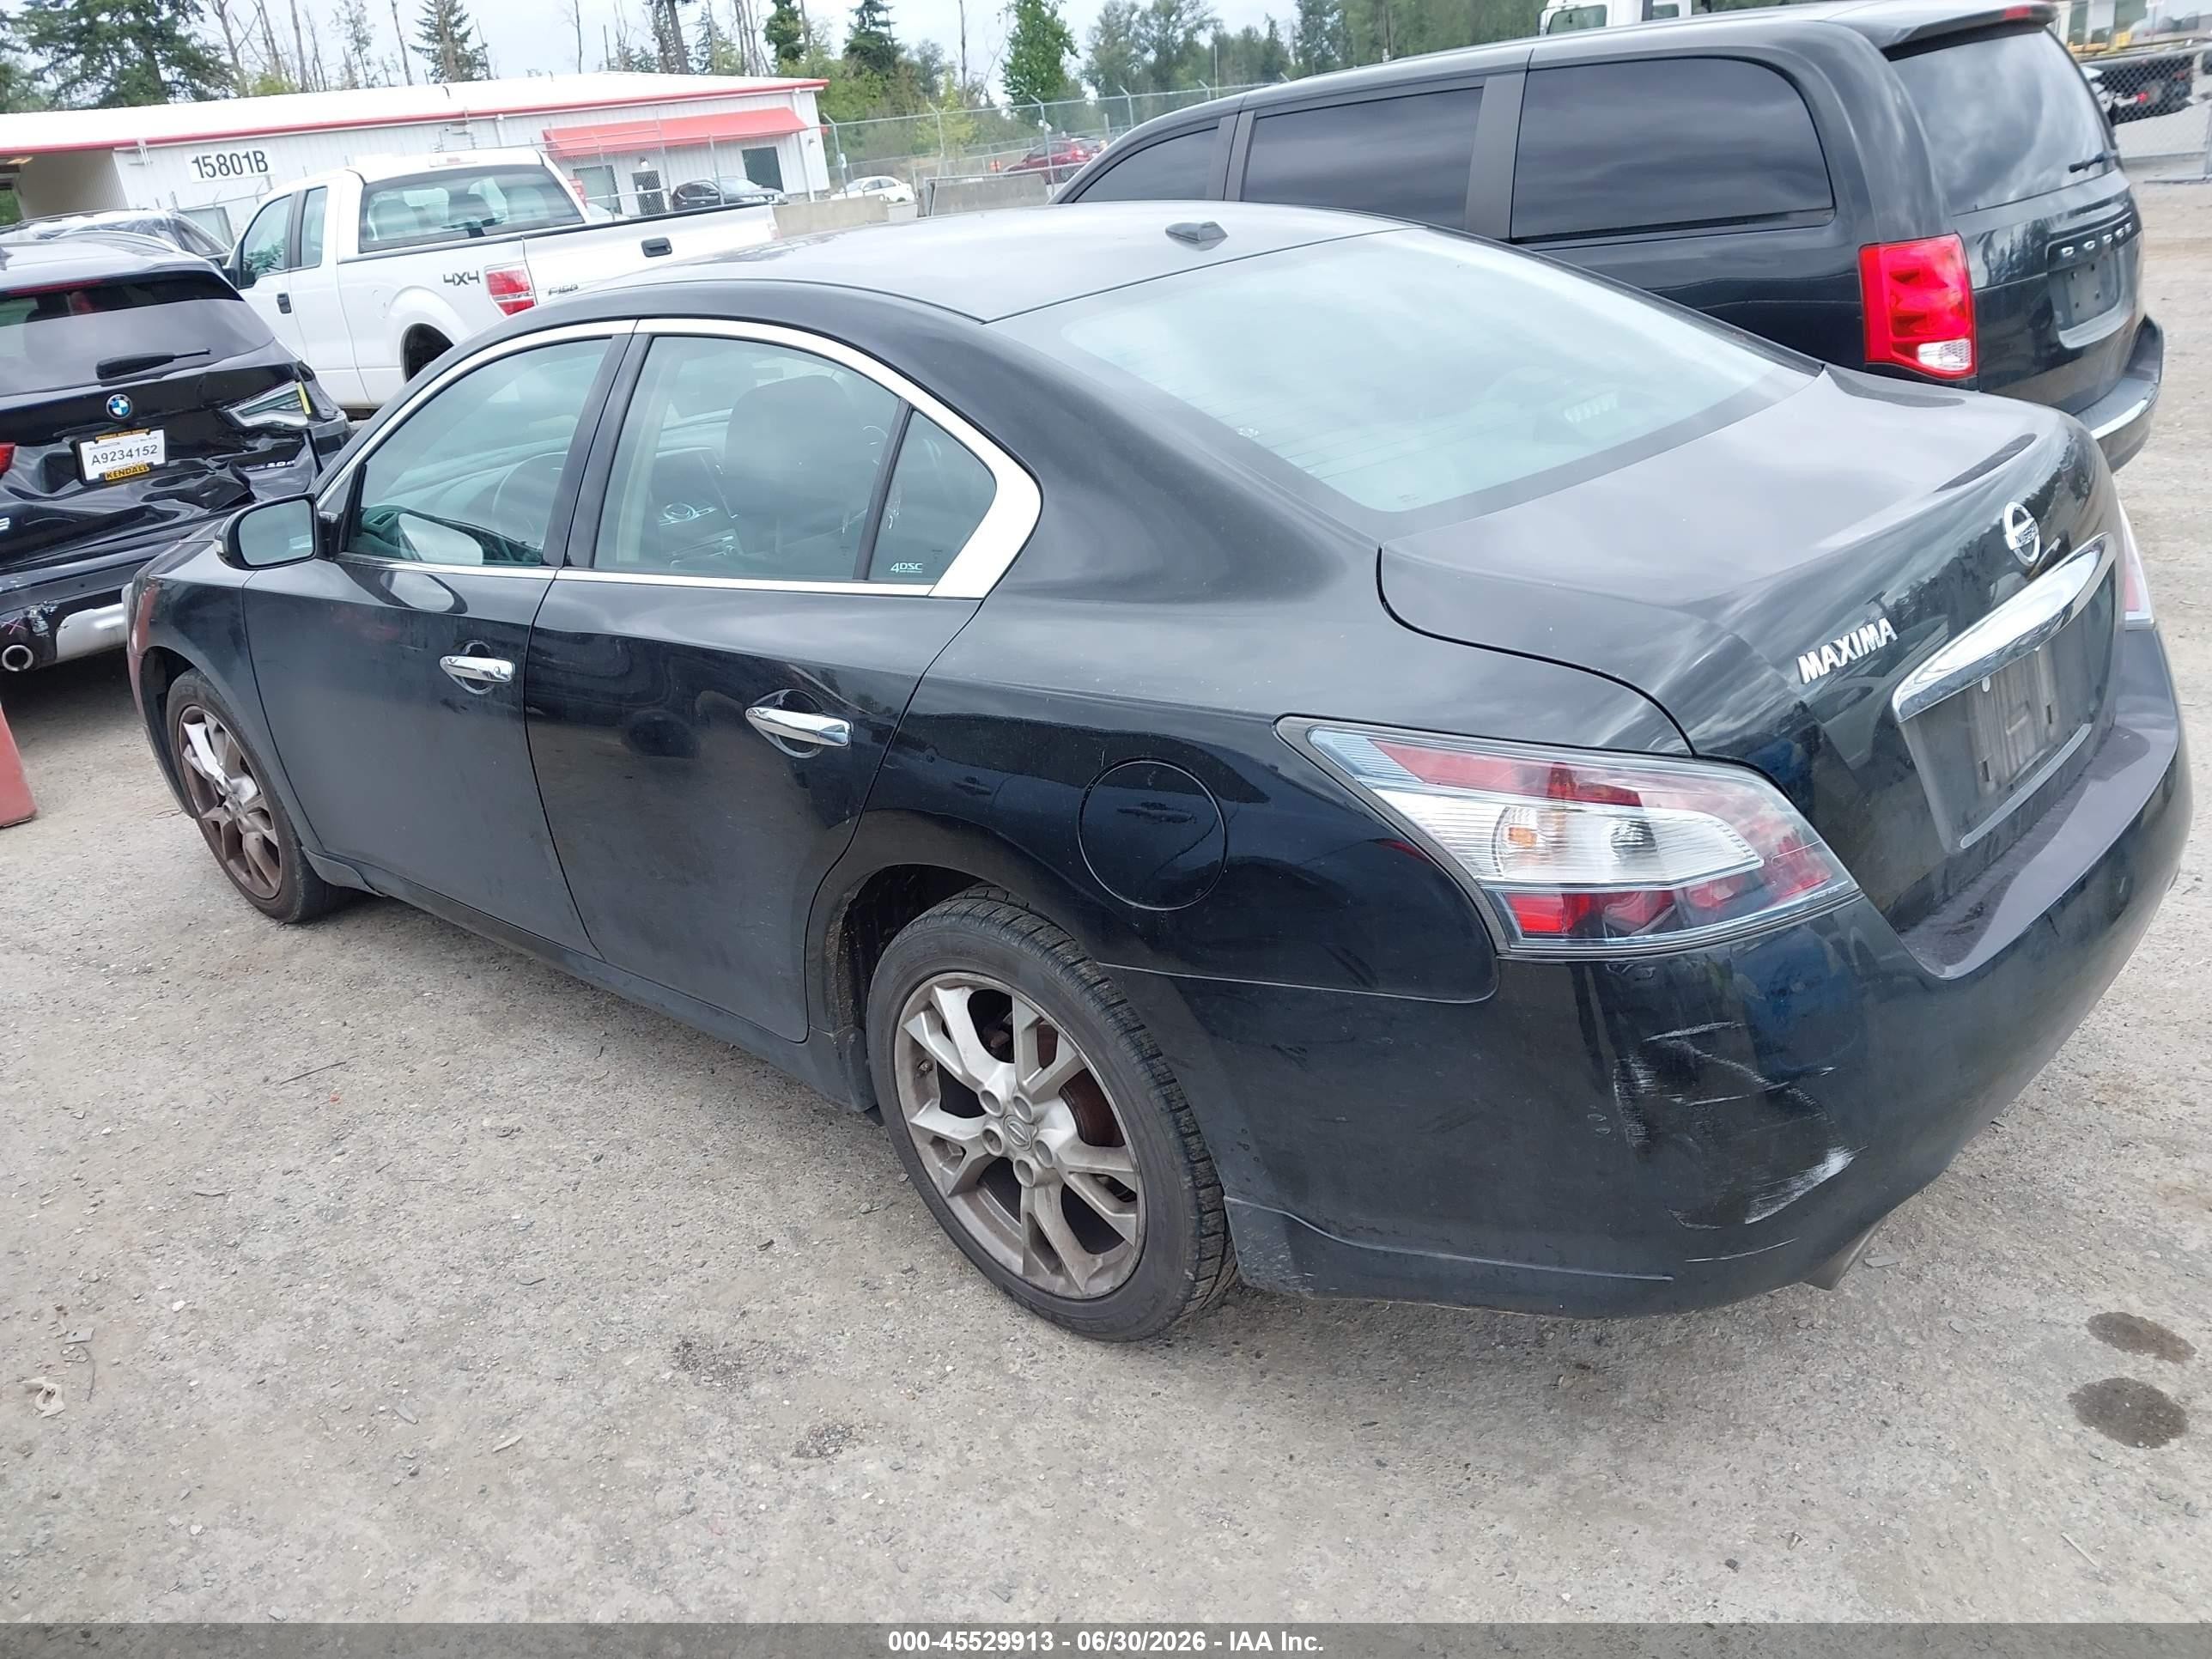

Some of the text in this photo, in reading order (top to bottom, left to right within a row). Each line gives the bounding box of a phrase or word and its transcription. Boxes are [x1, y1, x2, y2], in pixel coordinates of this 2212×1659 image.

[191, 149, 269, 179] 15801B
[91, 444, 158, 466] A9234152
[106, 465, 149, 479] KENDALL
[890, 562, 924, 574] 4DSC
[1796, 617, 1899, 685] MAXIMA
